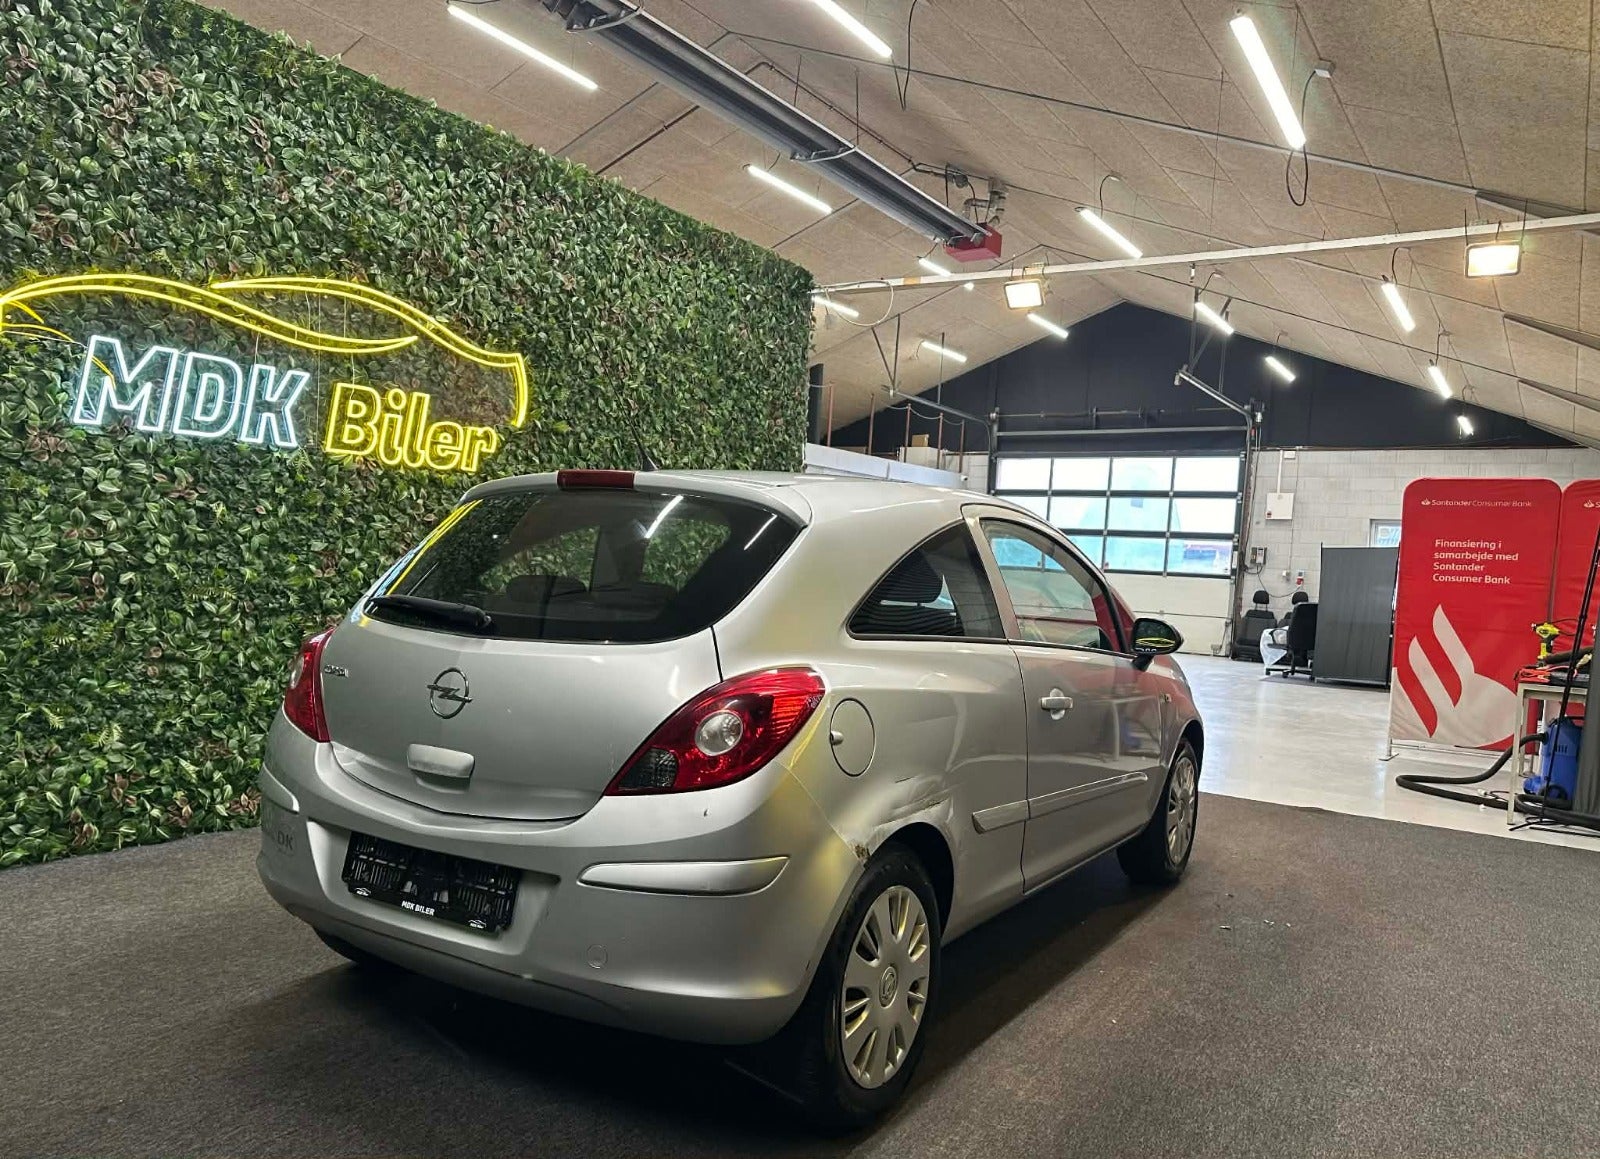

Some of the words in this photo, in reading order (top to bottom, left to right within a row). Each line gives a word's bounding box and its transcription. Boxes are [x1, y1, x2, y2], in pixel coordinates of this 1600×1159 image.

[72, 334, 310, 448] MDK
[325, 382, 498, 472] Biler
[1431, 499, 1471, 507] Santander
[1471, 500, 1510, 508] Consumer
[1512, 500, 1532, 508] Bank
[1434, 539, 1496, 551] Finansiering
[1498, 540, 1502, 549] i
[1433, 551, 1493, 562] samarbejde
[1495, 553, 1519, 561] med
[1432, 562, 1485, 572] Santander
[1432, 573, 1482, 583] Consumer
[1484, 575, 1511, 585] Bank
